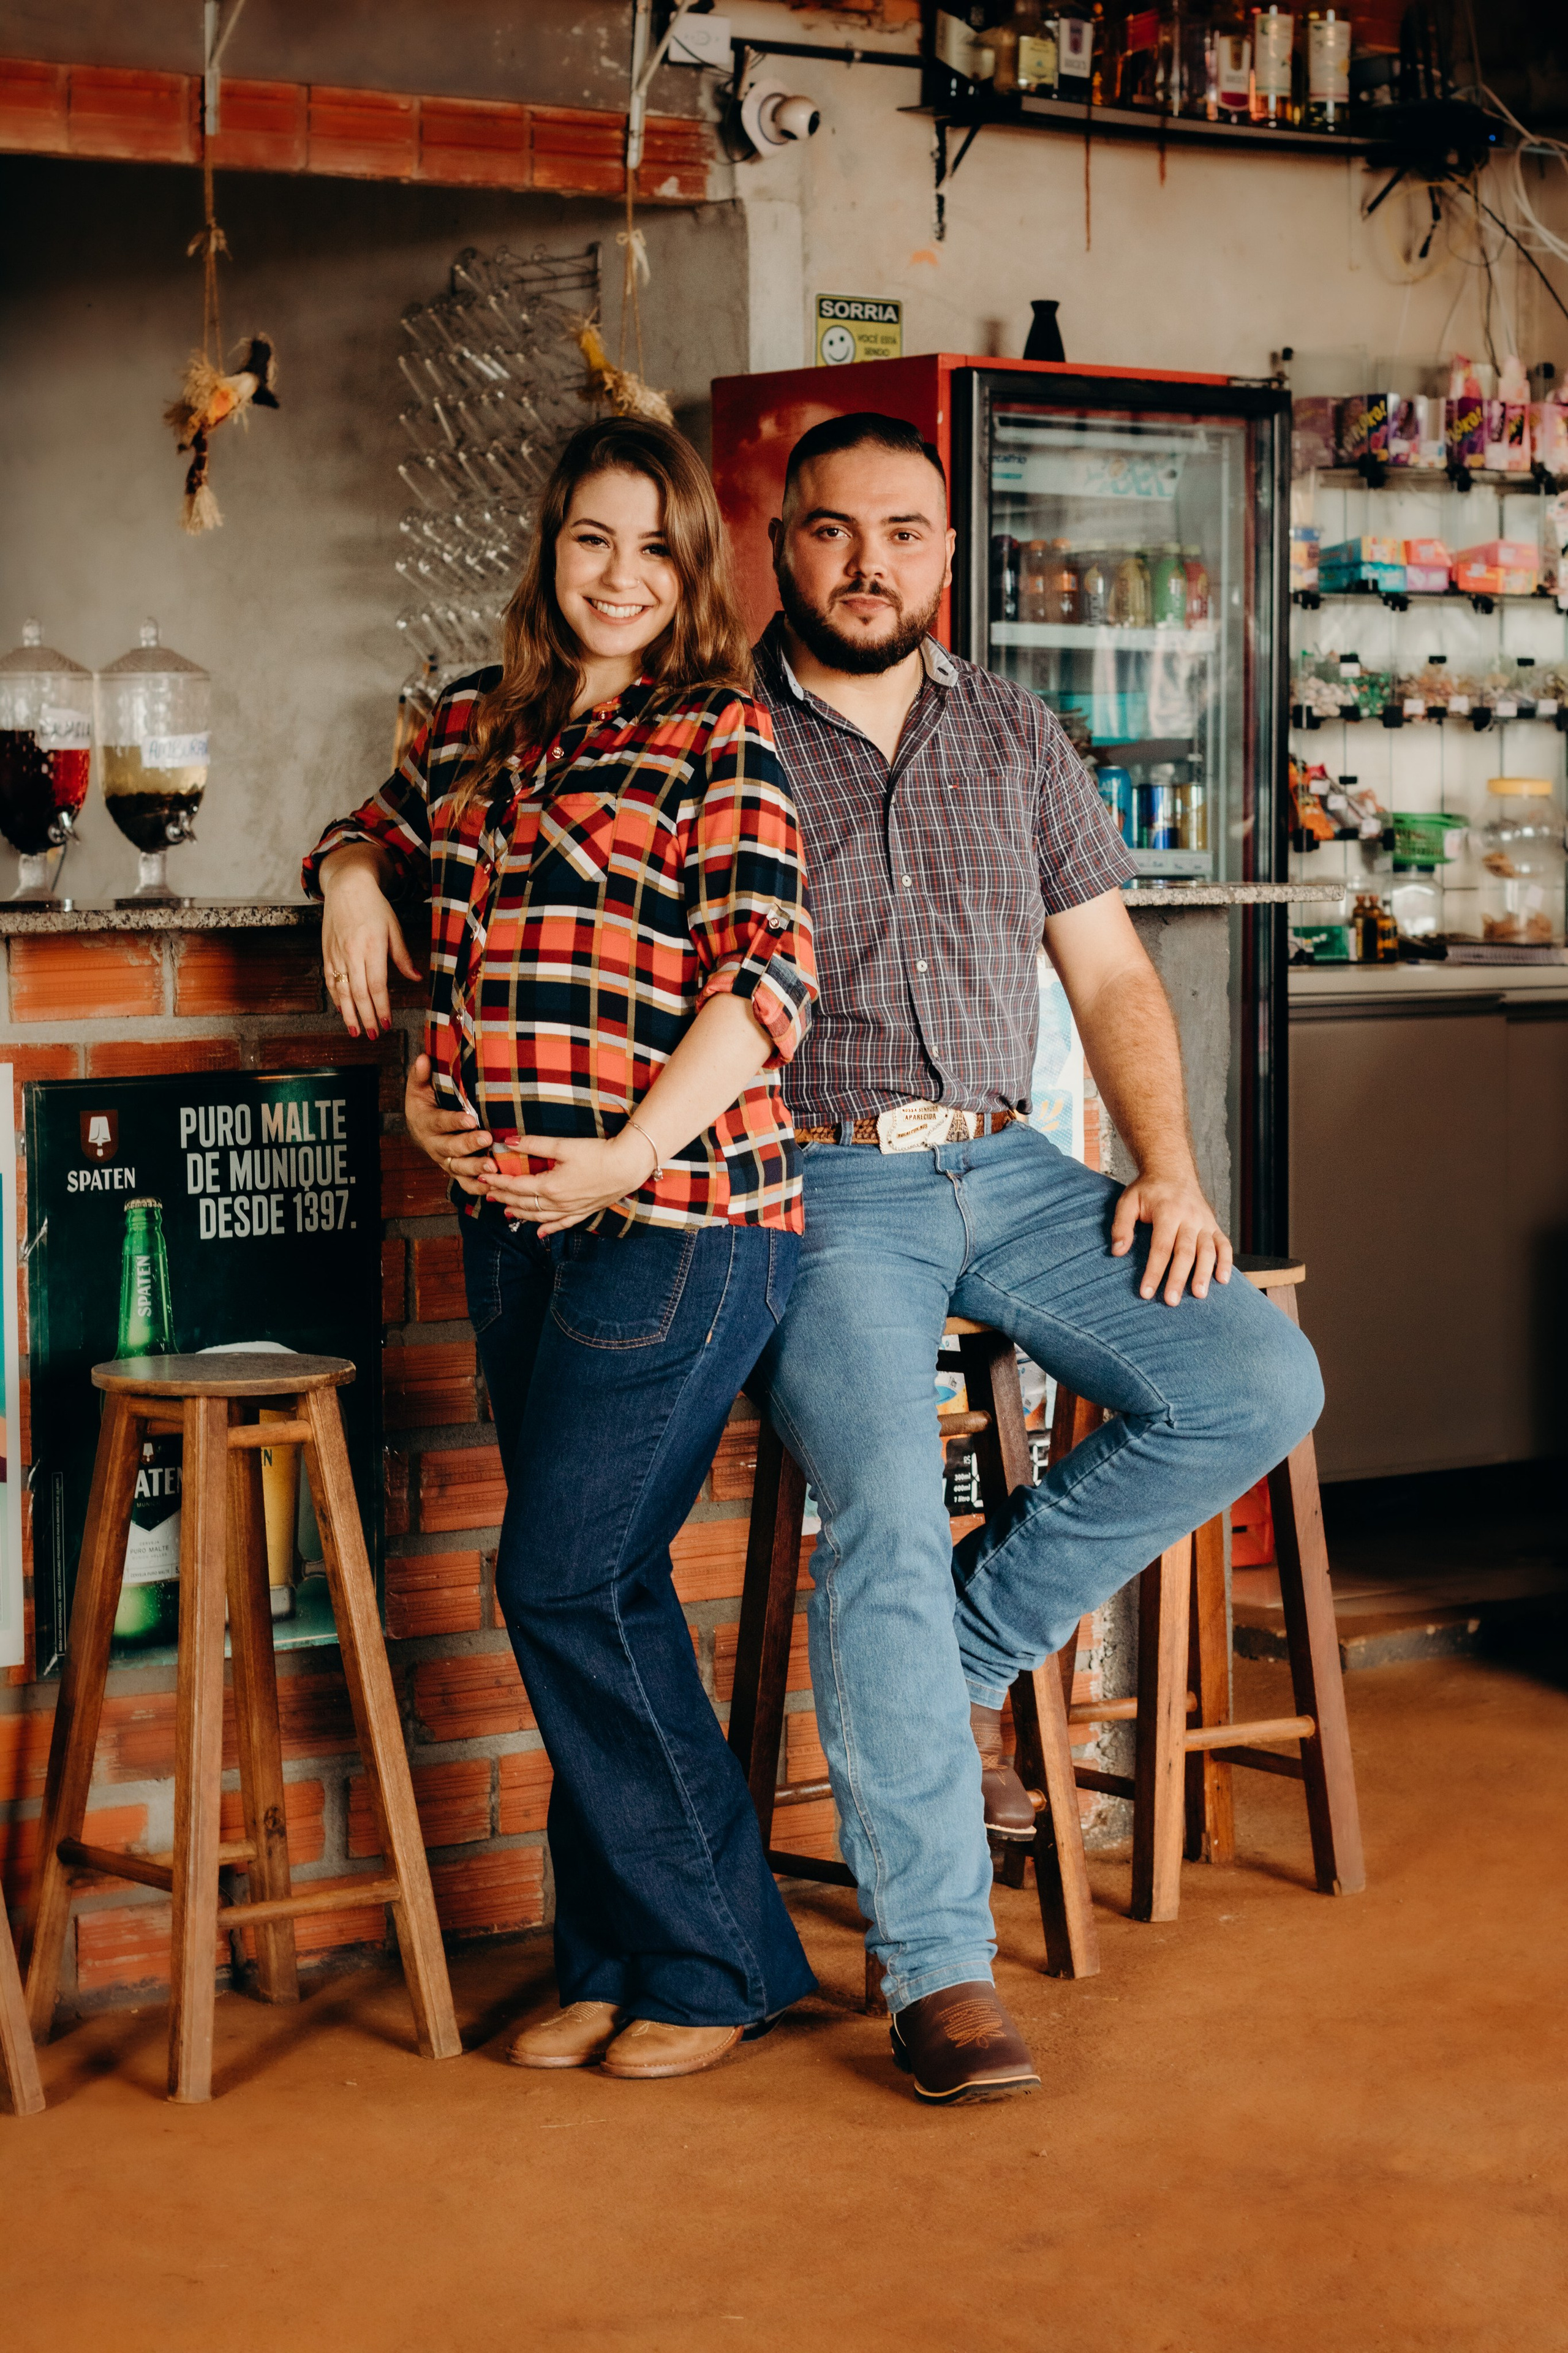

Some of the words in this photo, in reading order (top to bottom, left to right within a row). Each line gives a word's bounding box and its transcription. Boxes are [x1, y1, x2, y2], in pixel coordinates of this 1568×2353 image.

[821, 300, 898, 322] SORRIA
[179, 1104, 252, 1149] PURO
[262, 1099, 347, 1144] MALTE
[67, 1167, 135, 1193] SPATEN
[187, 1152, 221, 1195] DE
[230, 1145, 356, 1192] MUNIQUE.
[200, 1194, 285, 1241] DESDE
[293, 1190, 356, 1233] 1397.
[137, 1255, 152, 1318] SPATEN
[134, 1467, 183, 1499] ATEN
[953, 1483, 971, 1492] 600ml
[954, 1472, 971, 1481] 300ml
